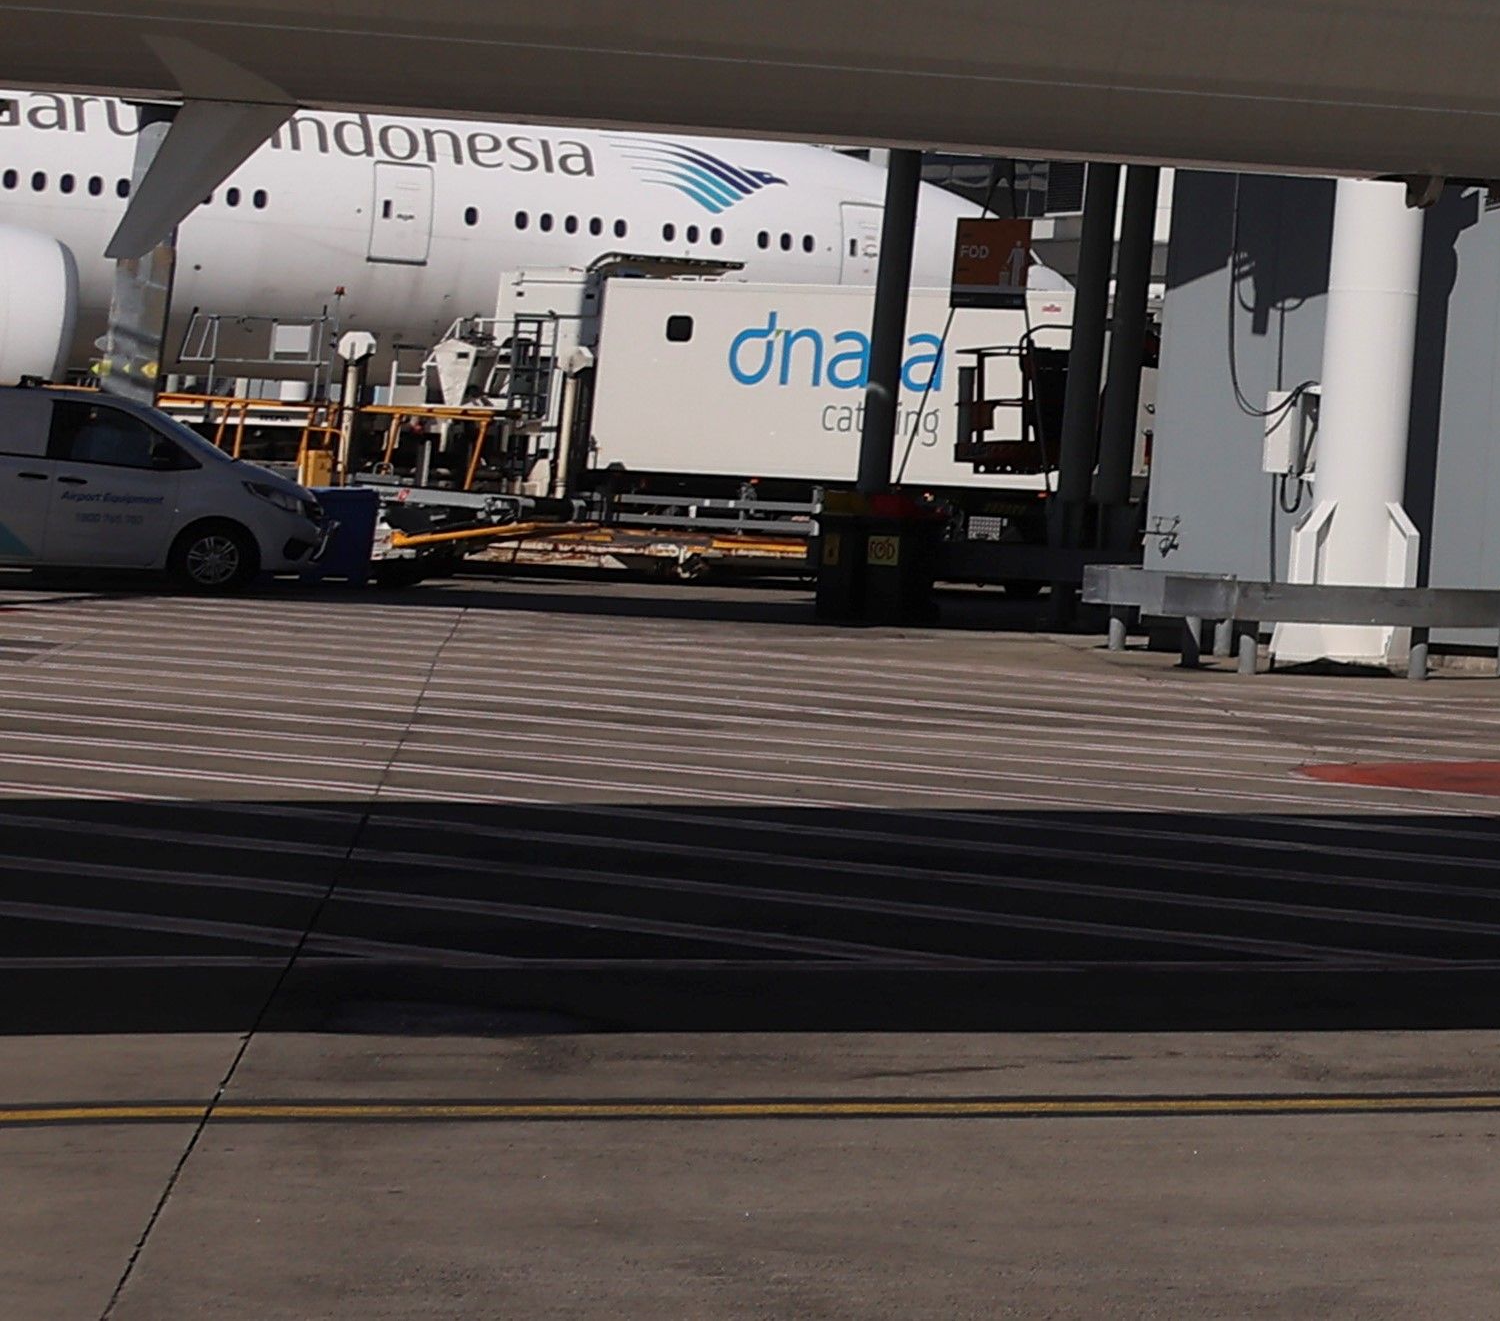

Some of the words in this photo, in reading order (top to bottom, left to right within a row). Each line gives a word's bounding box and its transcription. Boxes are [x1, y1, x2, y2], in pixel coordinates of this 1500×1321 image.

[960, 245, 990, 258] FOD
[728, 311, 944, 392] dnaa
[821, 402, 939, 447] cating
